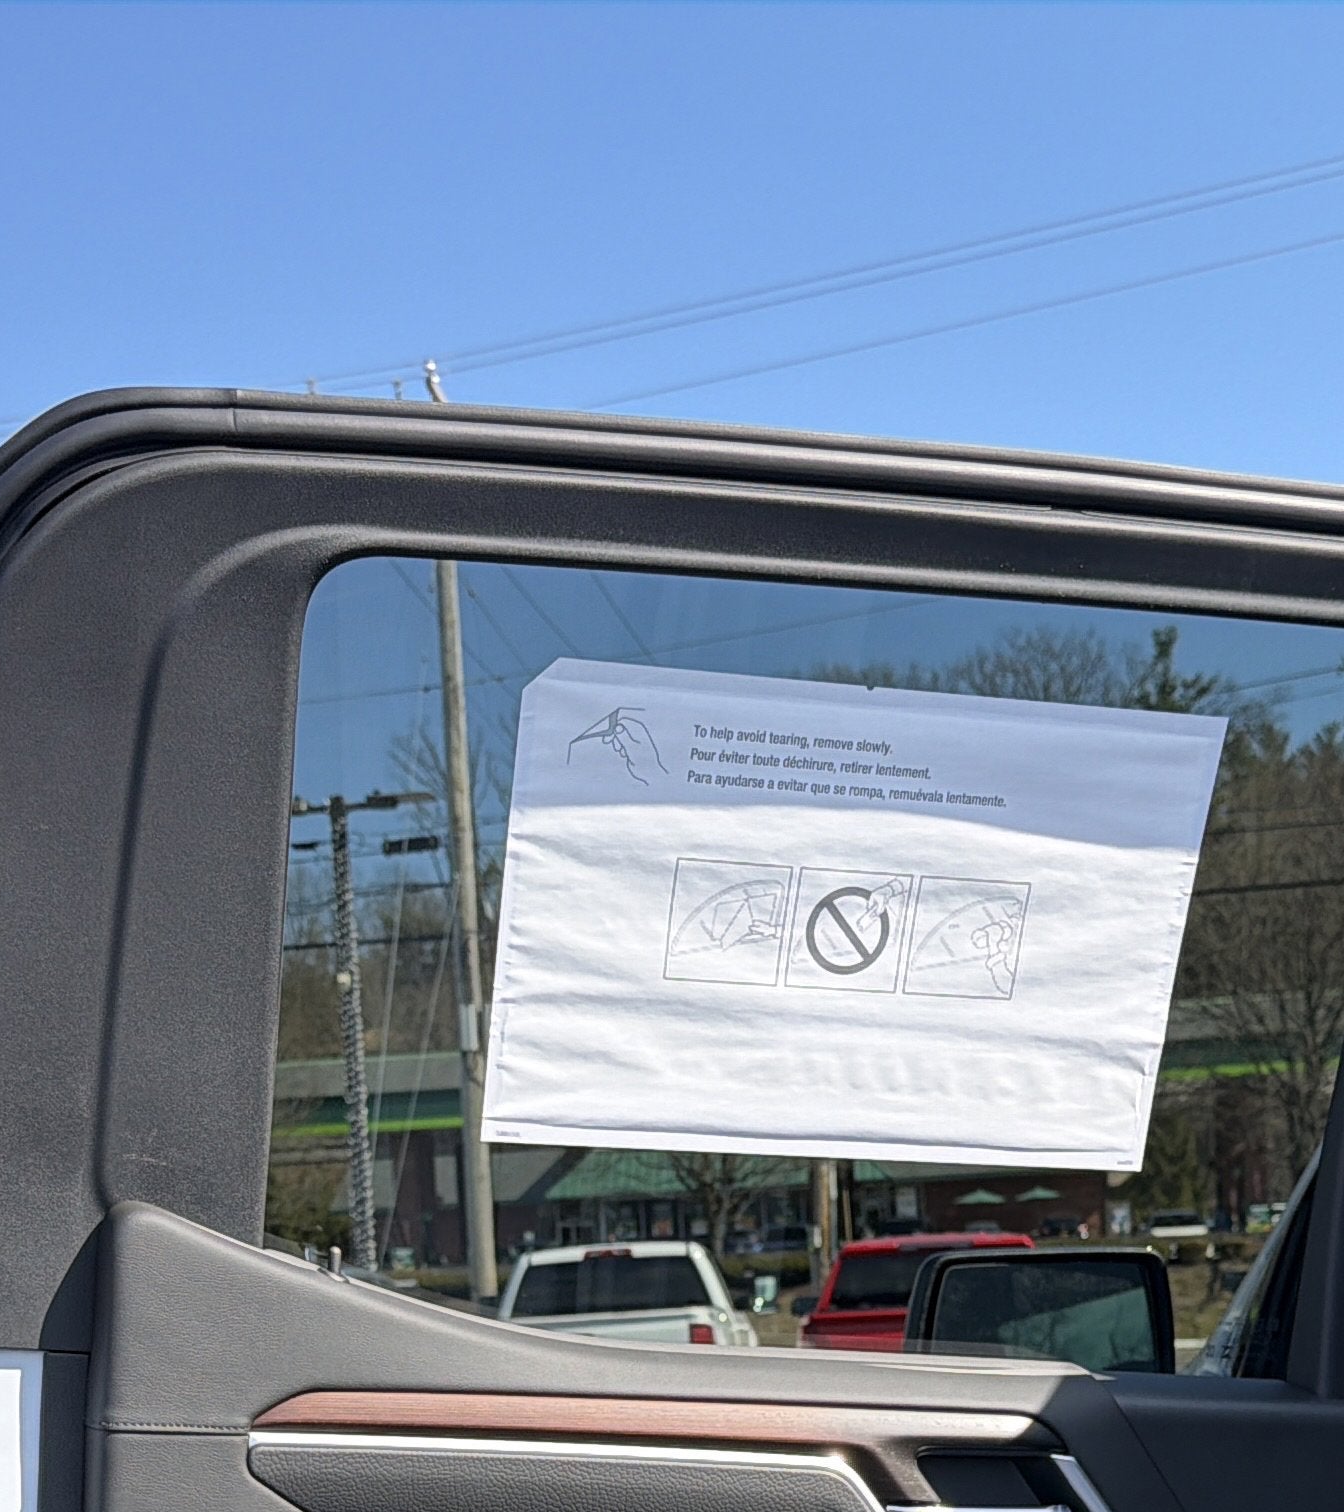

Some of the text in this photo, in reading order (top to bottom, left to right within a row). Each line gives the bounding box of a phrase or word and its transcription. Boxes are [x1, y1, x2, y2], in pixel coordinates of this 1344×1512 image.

[694, 725, 893, 756] To help avoid tearing, remove slowly.
[690, 747, 931, 780] Pour éviter toute déchirure, retirer lentement.
[687, 770, 1007, 808] Para ayudarse a evitar que se rompa, remuévala lentamente.
